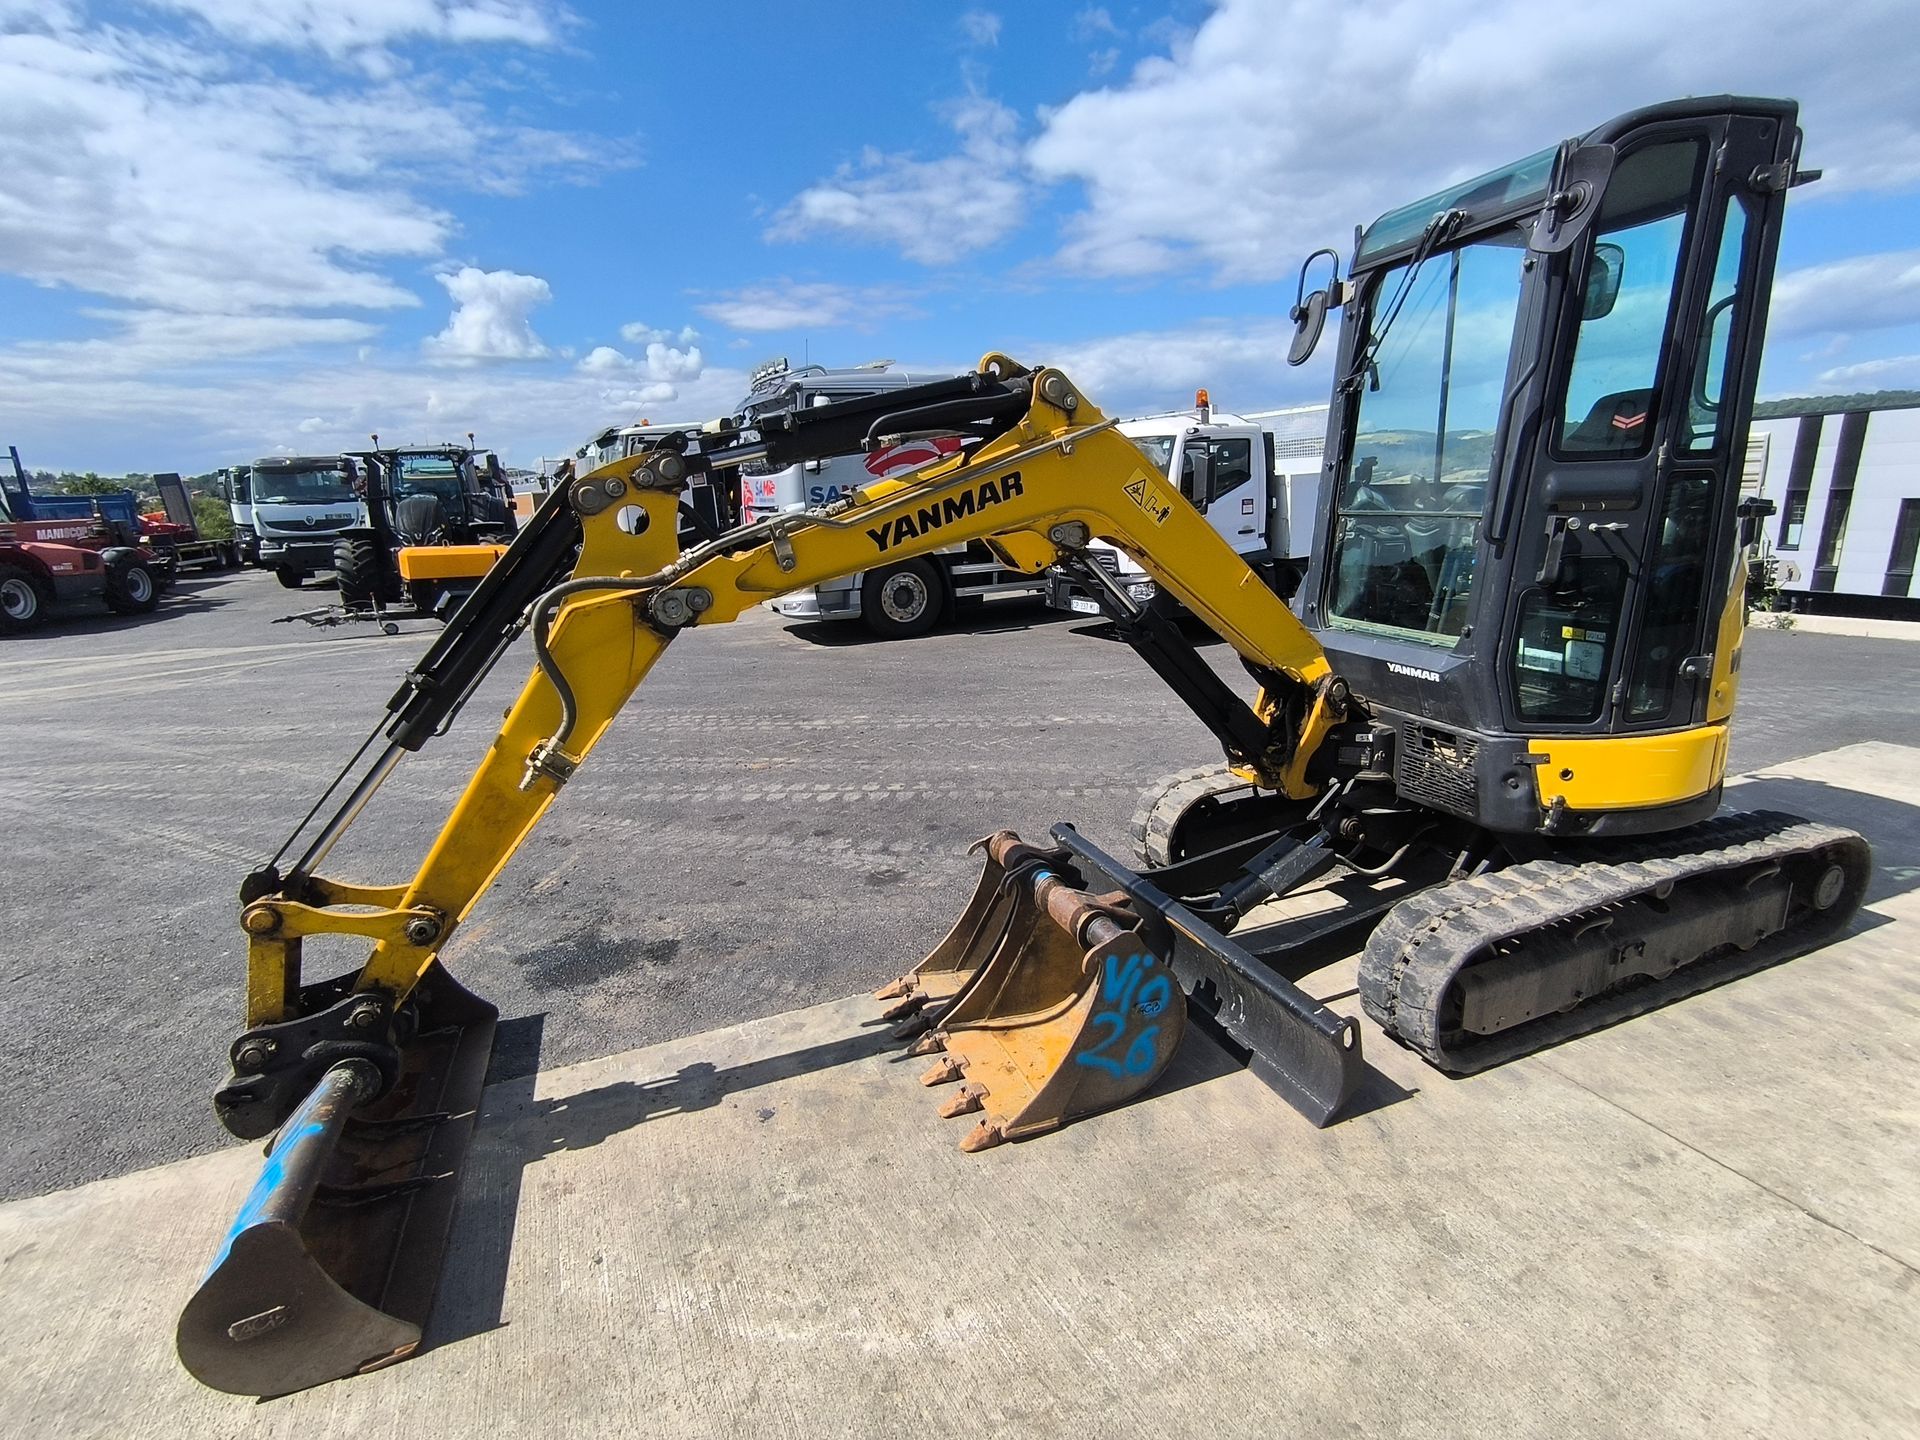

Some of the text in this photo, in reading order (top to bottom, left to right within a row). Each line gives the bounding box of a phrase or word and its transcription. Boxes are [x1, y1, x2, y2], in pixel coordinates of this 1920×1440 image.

[866, 471, 1024, 552] YANMAR
[1386, 662, 1440, 682] YANMAR
[1076, 1011, 1160, 1080] 26
